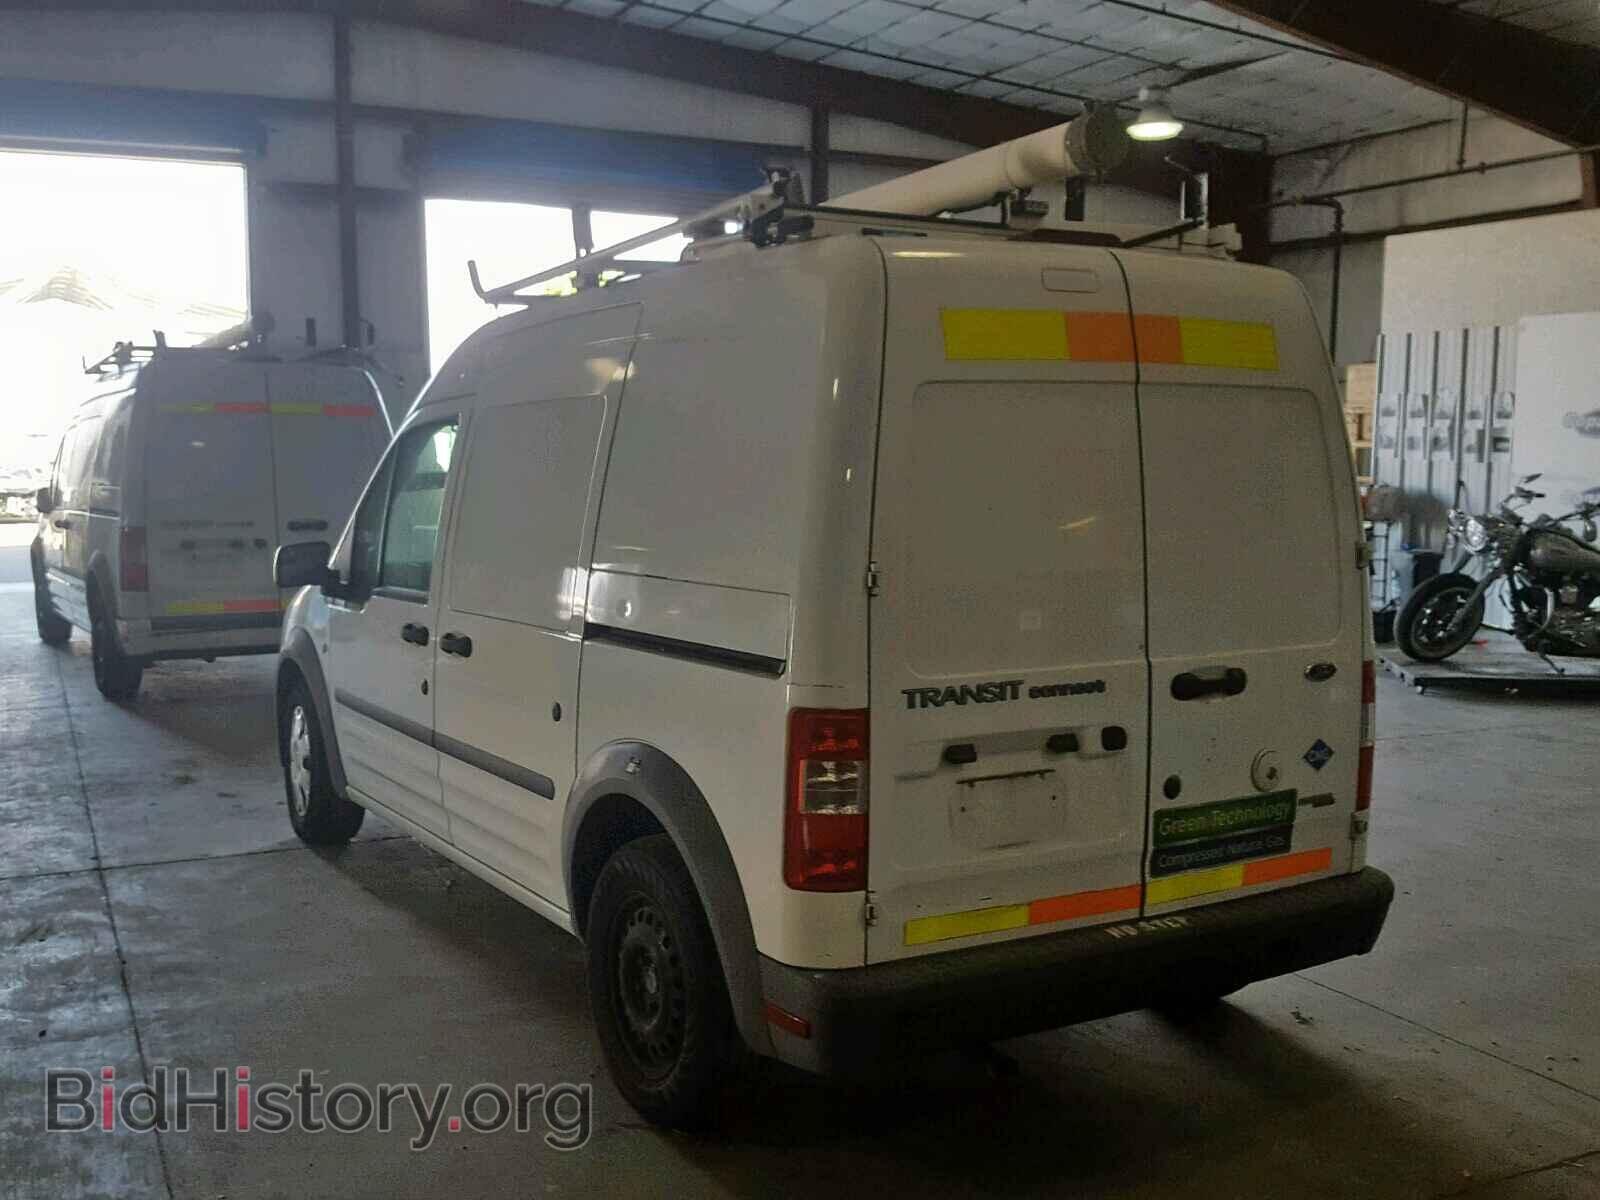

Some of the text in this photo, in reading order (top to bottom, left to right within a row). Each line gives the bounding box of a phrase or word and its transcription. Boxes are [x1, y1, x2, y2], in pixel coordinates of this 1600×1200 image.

[901, 680, 1105, 709] TRANSIT connect
[1159, 801, 1291, 836] Green Technology
